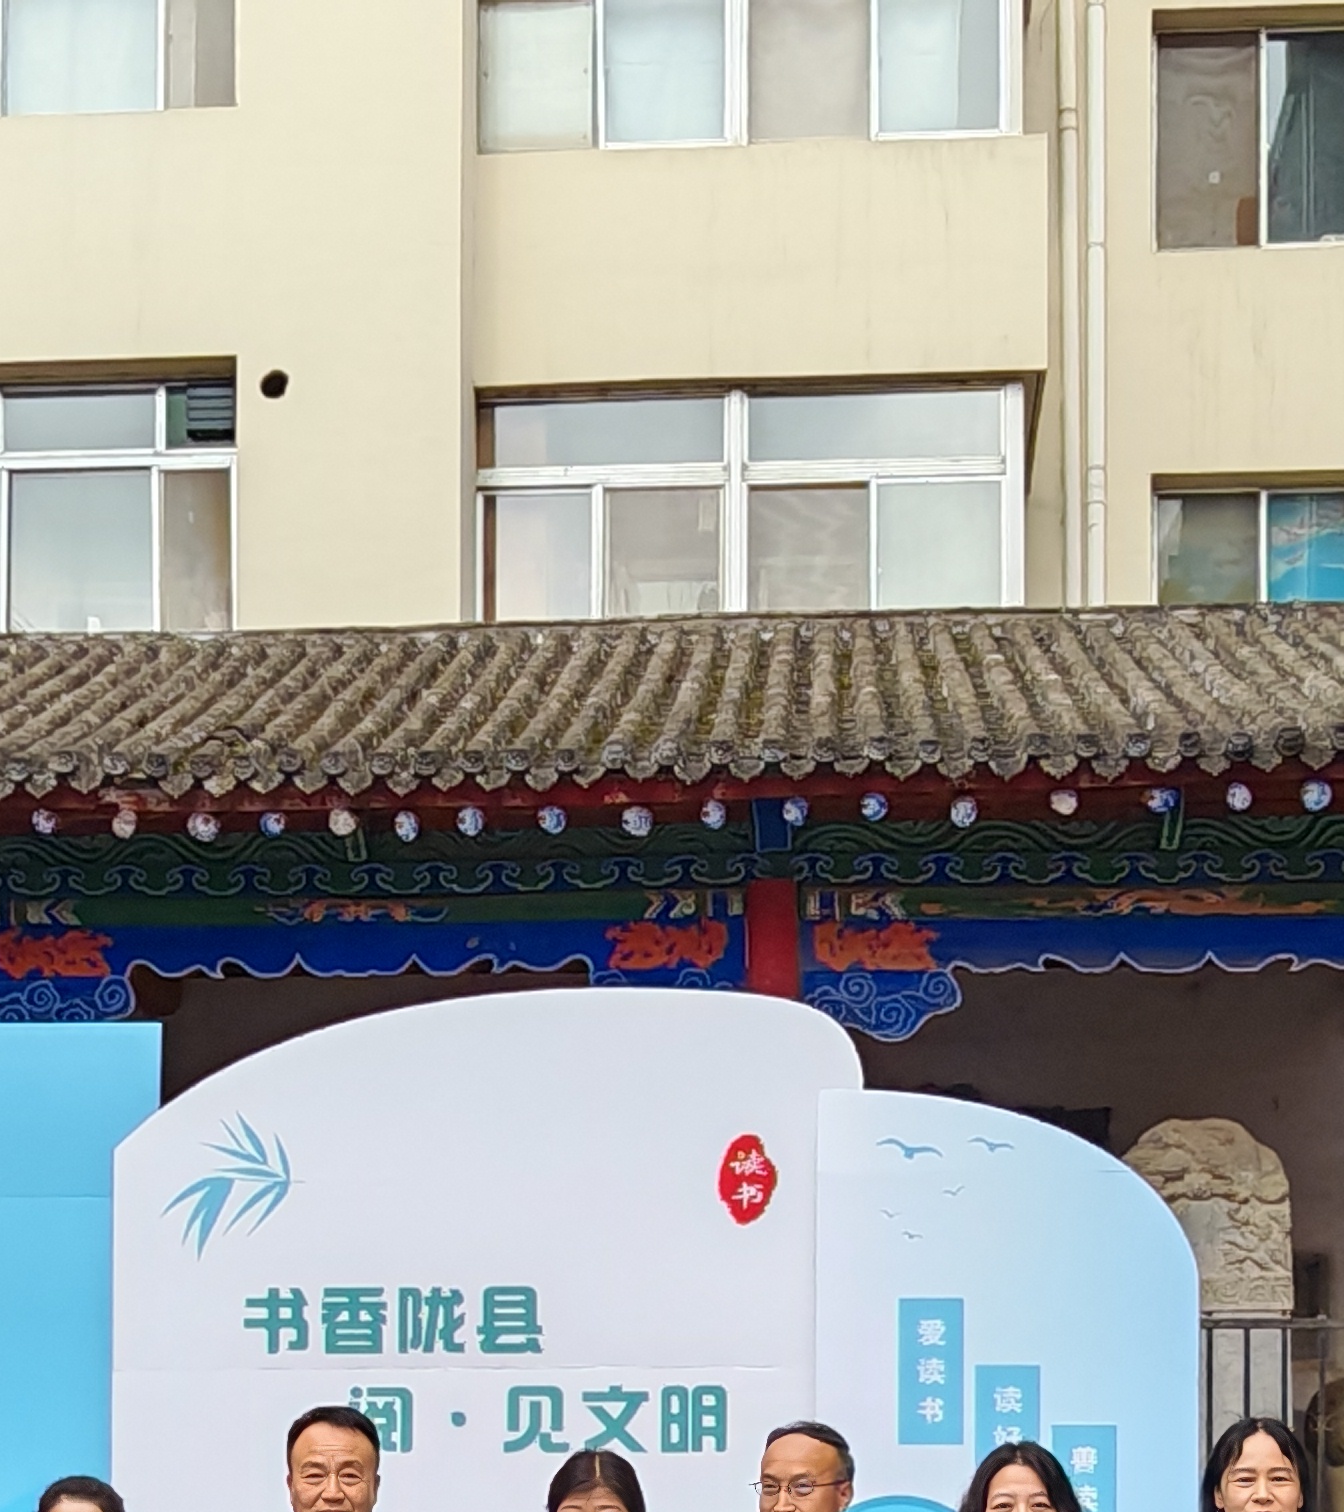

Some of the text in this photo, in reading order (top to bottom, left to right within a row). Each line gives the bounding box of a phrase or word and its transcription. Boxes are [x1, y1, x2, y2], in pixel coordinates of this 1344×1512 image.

[729, 1148, 768, 1210] 读书
[243, 1286, 544, 1355] 书香陇县
[917, 1319, 947, 1423] 爱读书
